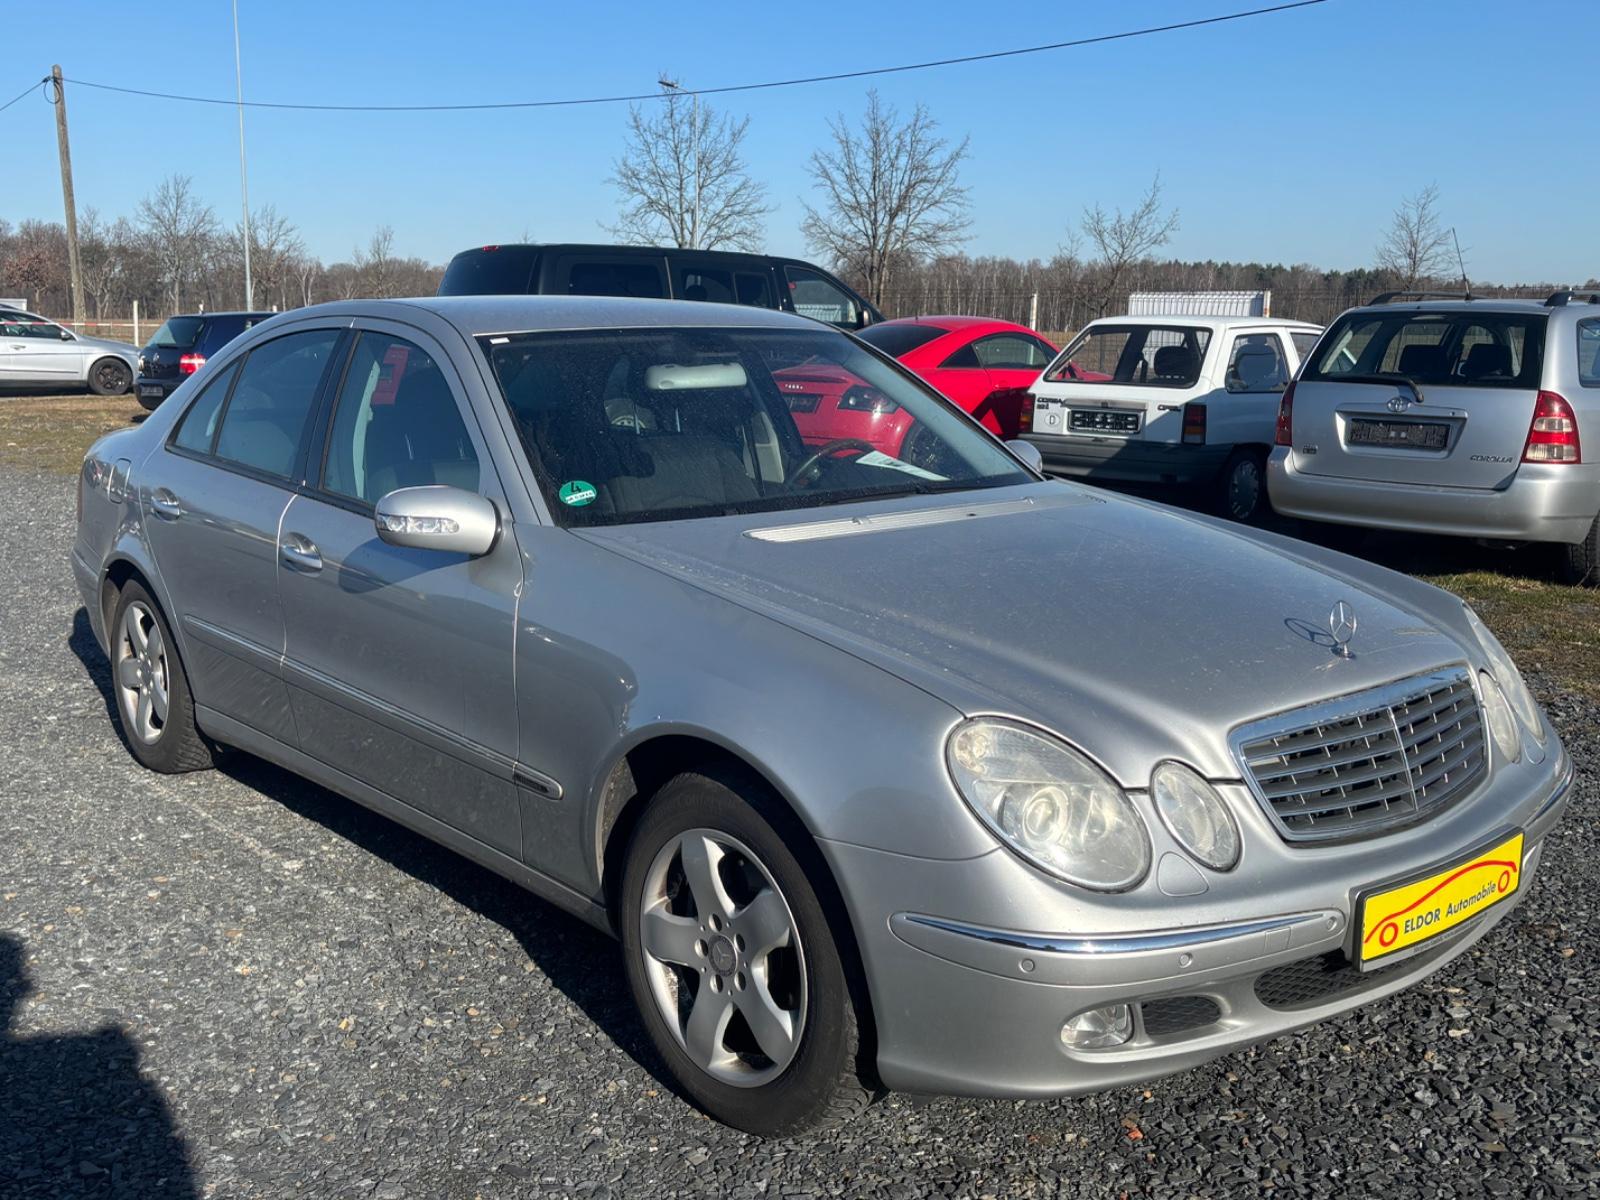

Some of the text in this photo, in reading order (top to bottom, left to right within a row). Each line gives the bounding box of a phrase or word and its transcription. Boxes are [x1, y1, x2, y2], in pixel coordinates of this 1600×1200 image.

[1470, 454, 1513, 463] COROLLA
[571, 481, 582, 493] 4
[1404, 908, 1441, 934] ELDOR
[1446, 881, 1497, 918] Automobile
